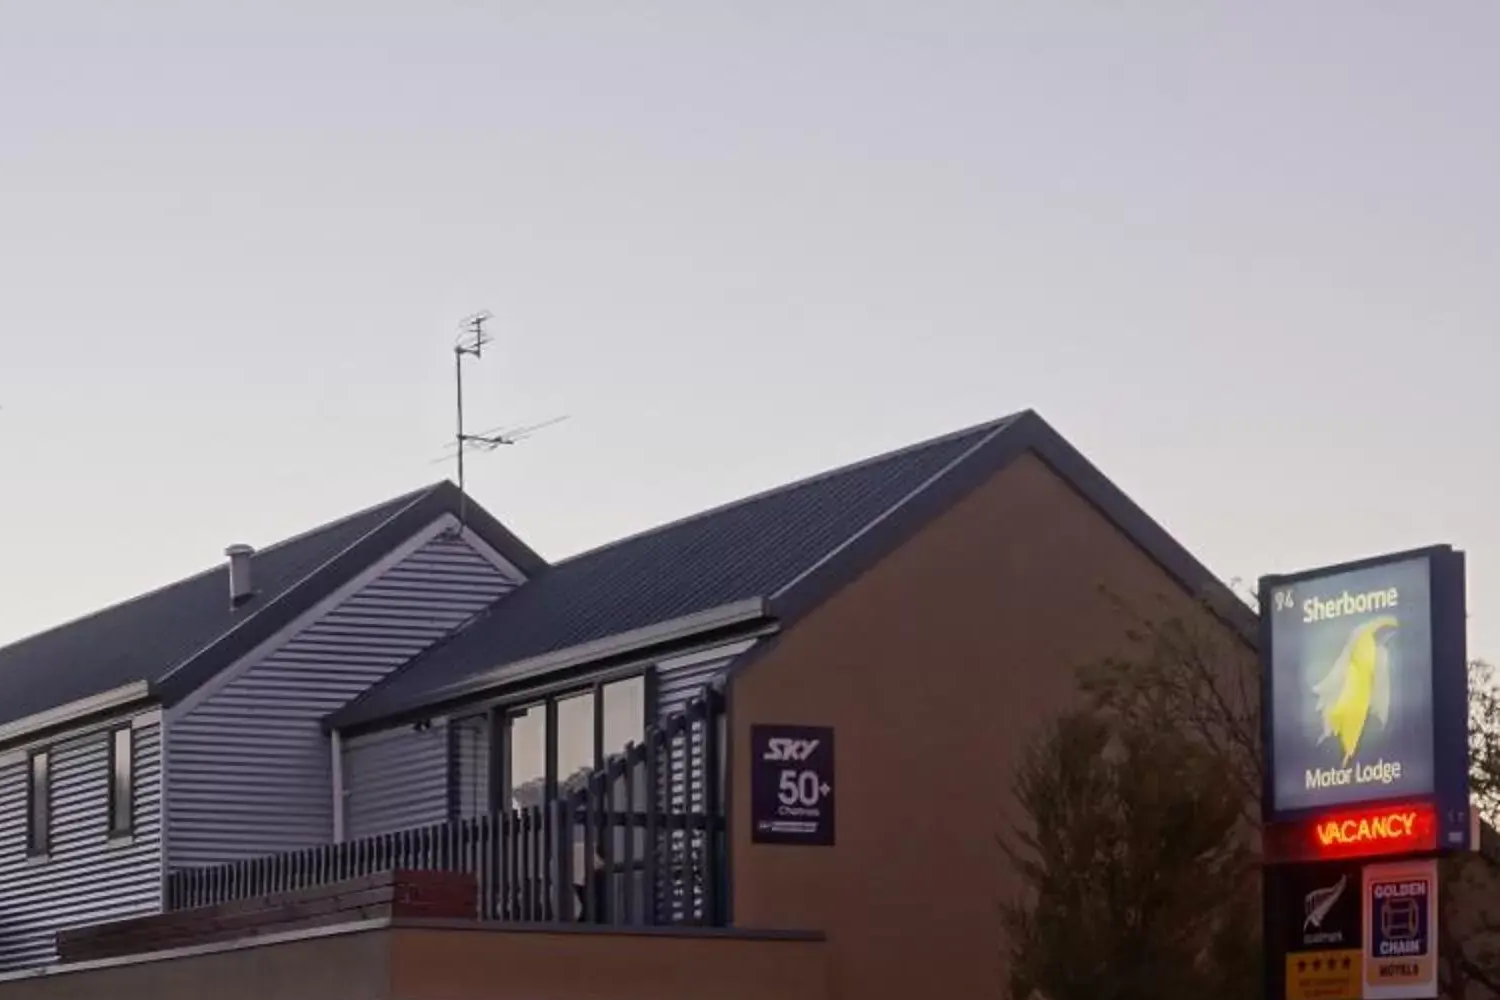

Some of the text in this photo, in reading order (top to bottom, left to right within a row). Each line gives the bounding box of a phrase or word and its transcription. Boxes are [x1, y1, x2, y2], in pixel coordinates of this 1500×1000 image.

[1275, 591, 1294, 611] 94
[1303, 586, 1398, 623] Sherborne
[763, 738, 820, 760] SKY
[1305, 758, 1401, 790] Motor Lodge
[1317, 813, 1417, 845] VACANCY
[1374, 882, 1425, 899] GOLDEN
[1380, 939, 1420, 955] CHAIN
